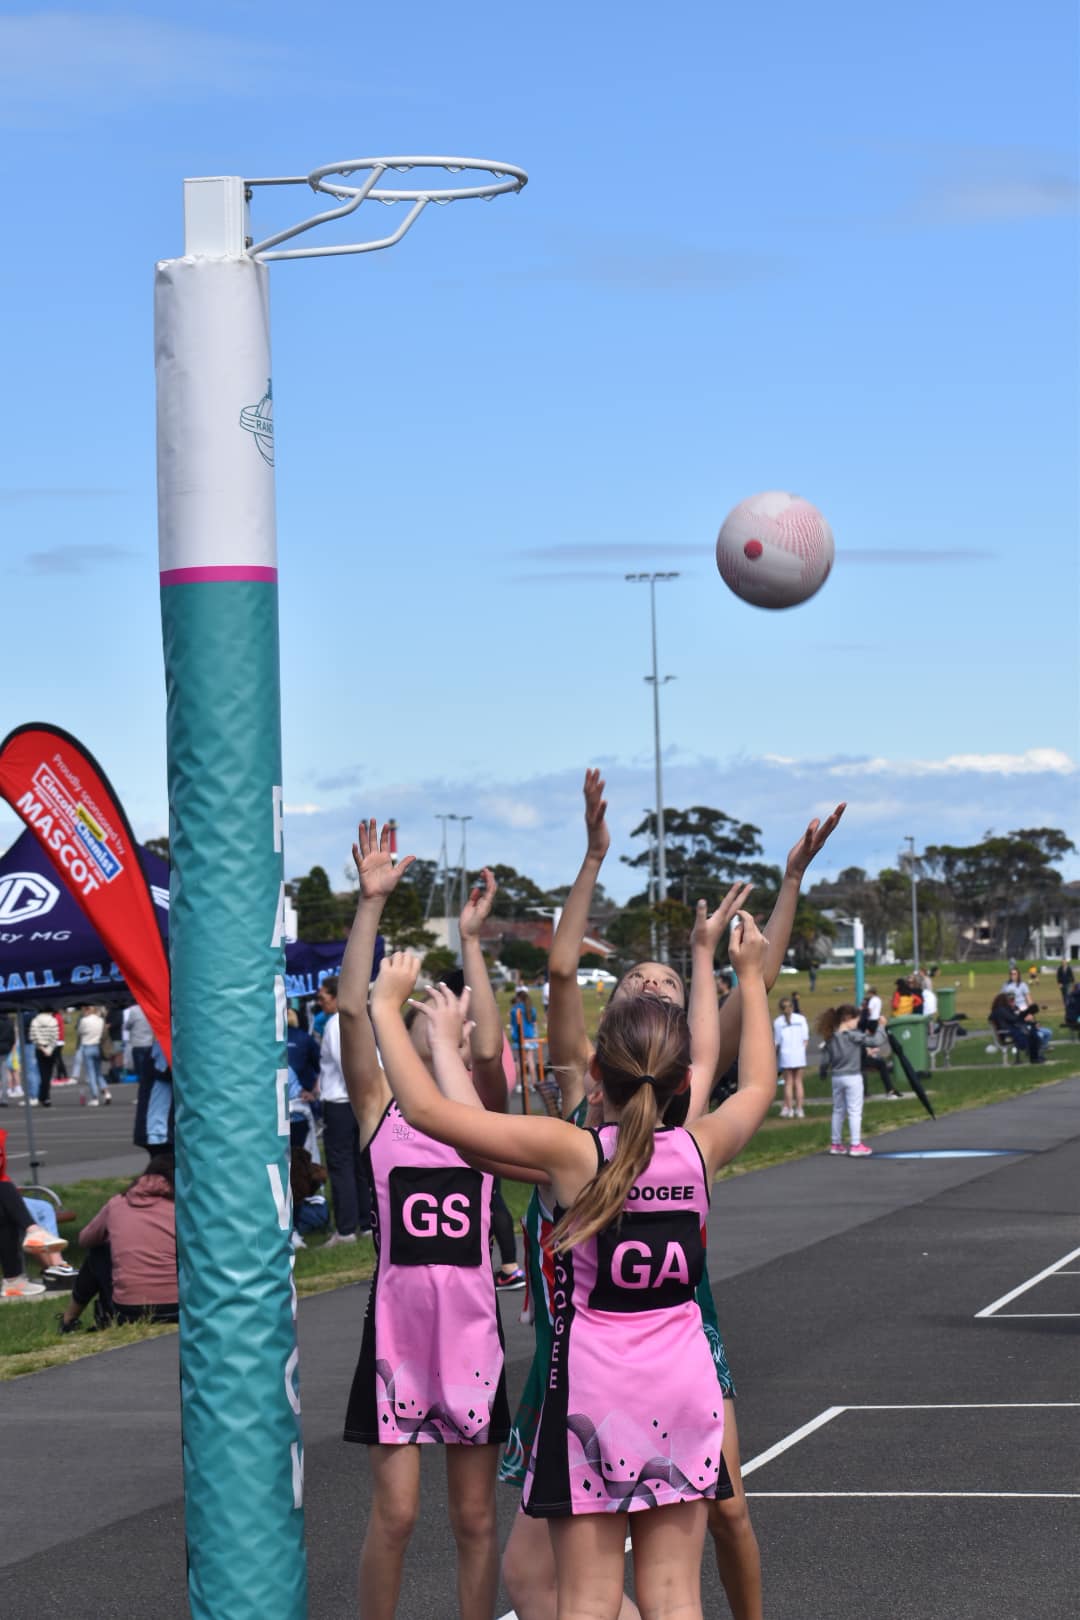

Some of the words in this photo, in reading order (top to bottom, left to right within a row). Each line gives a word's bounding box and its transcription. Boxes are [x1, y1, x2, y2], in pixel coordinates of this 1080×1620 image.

[16, 791, 100, 895] MASCOT
[30, 930, 72, 941] MG
[402, 1192, 471, 1239] GS
[627, 1185, 695, 1201] OOGEE
[610, 1240, 690, 1290] GA
